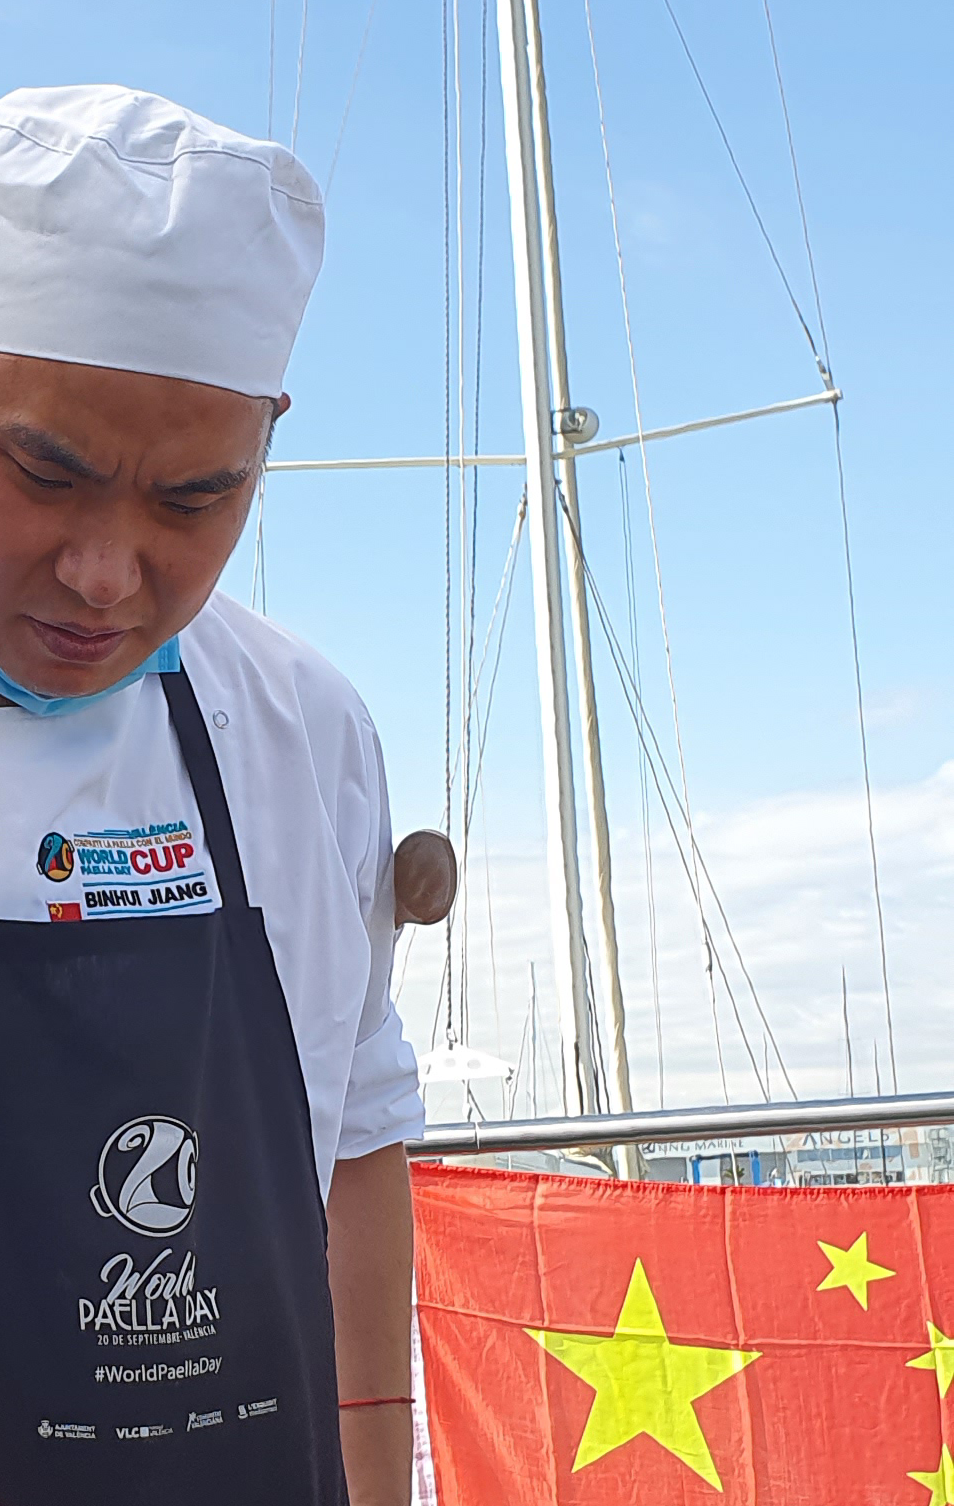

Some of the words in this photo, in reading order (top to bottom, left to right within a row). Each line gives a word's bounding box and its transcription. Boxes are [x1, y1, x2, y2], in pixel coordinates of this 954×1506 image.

[136, 837, 153, 848] CON
[77, 848, 128, 865] WORLD
[130, 842, 194, 875] CUP
[80, 865, 114, 875] PAELLA
[114, 865, 132, 876] DAY
[84, 889, 142, 908] BINHUI
[148, 881, 208, 904] JIANG
[100, 1248, 197, 1304] World
[79, 1298, 180, 1331] PAELLA
[185, 1287, 221, 1326] DAY
[97, 1334, 109, 1345] 20
[112, 1334, 124, 1345] DE
[94, 1355, 222, 1383] #WorldPaellaDay
[115, 1426, 139, 1439] VLC
